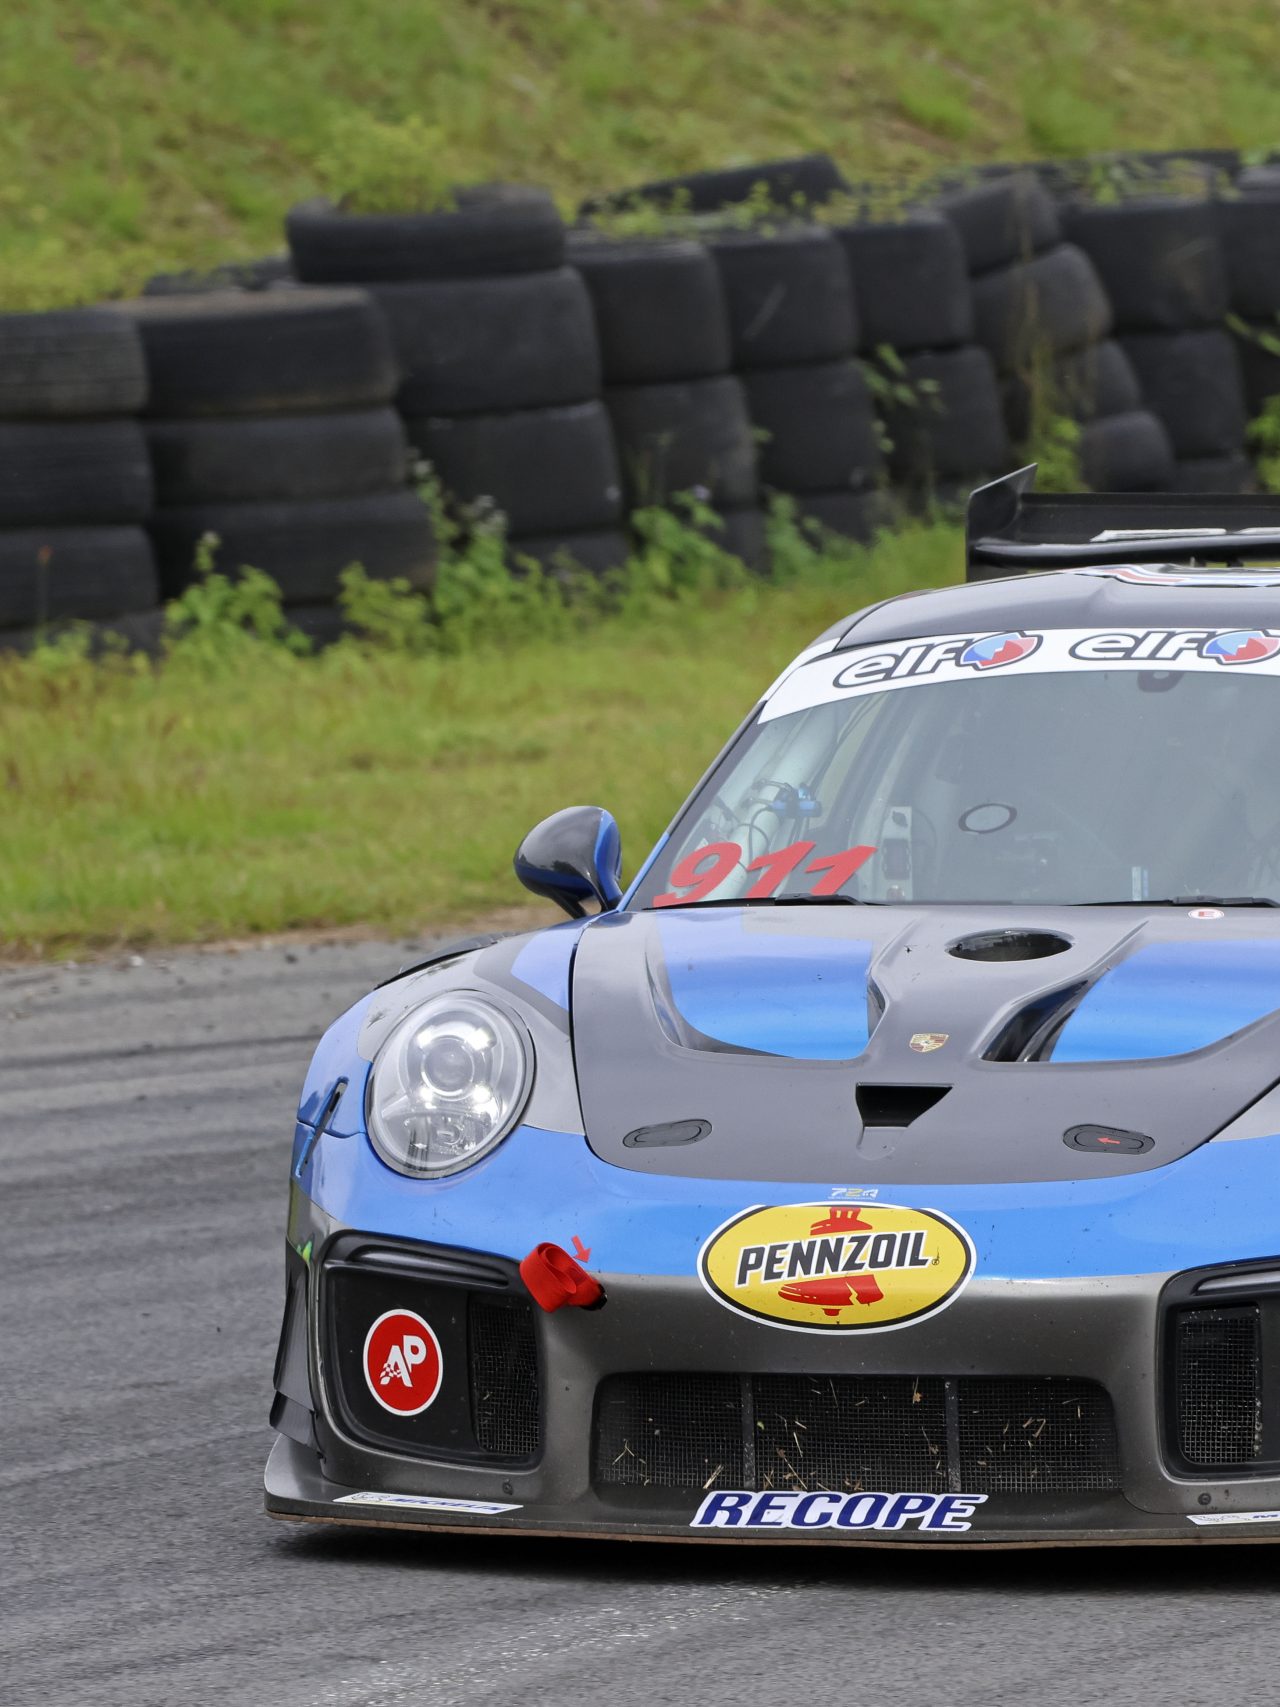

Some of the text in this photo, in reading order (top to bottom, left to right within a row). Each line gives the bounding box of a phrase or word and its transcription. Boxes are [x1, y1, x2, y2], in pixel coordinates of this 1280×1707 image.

[833, 637, 972, 688] elf
[1069, 630, 1208, 661] elf
[652, 841, 878, 907] 911
[737, 1231, 933, 1288] PENNZOIL
[380, 1335, 427, 1388] AP
[691, 1490, 988, 1532] RECOPE
